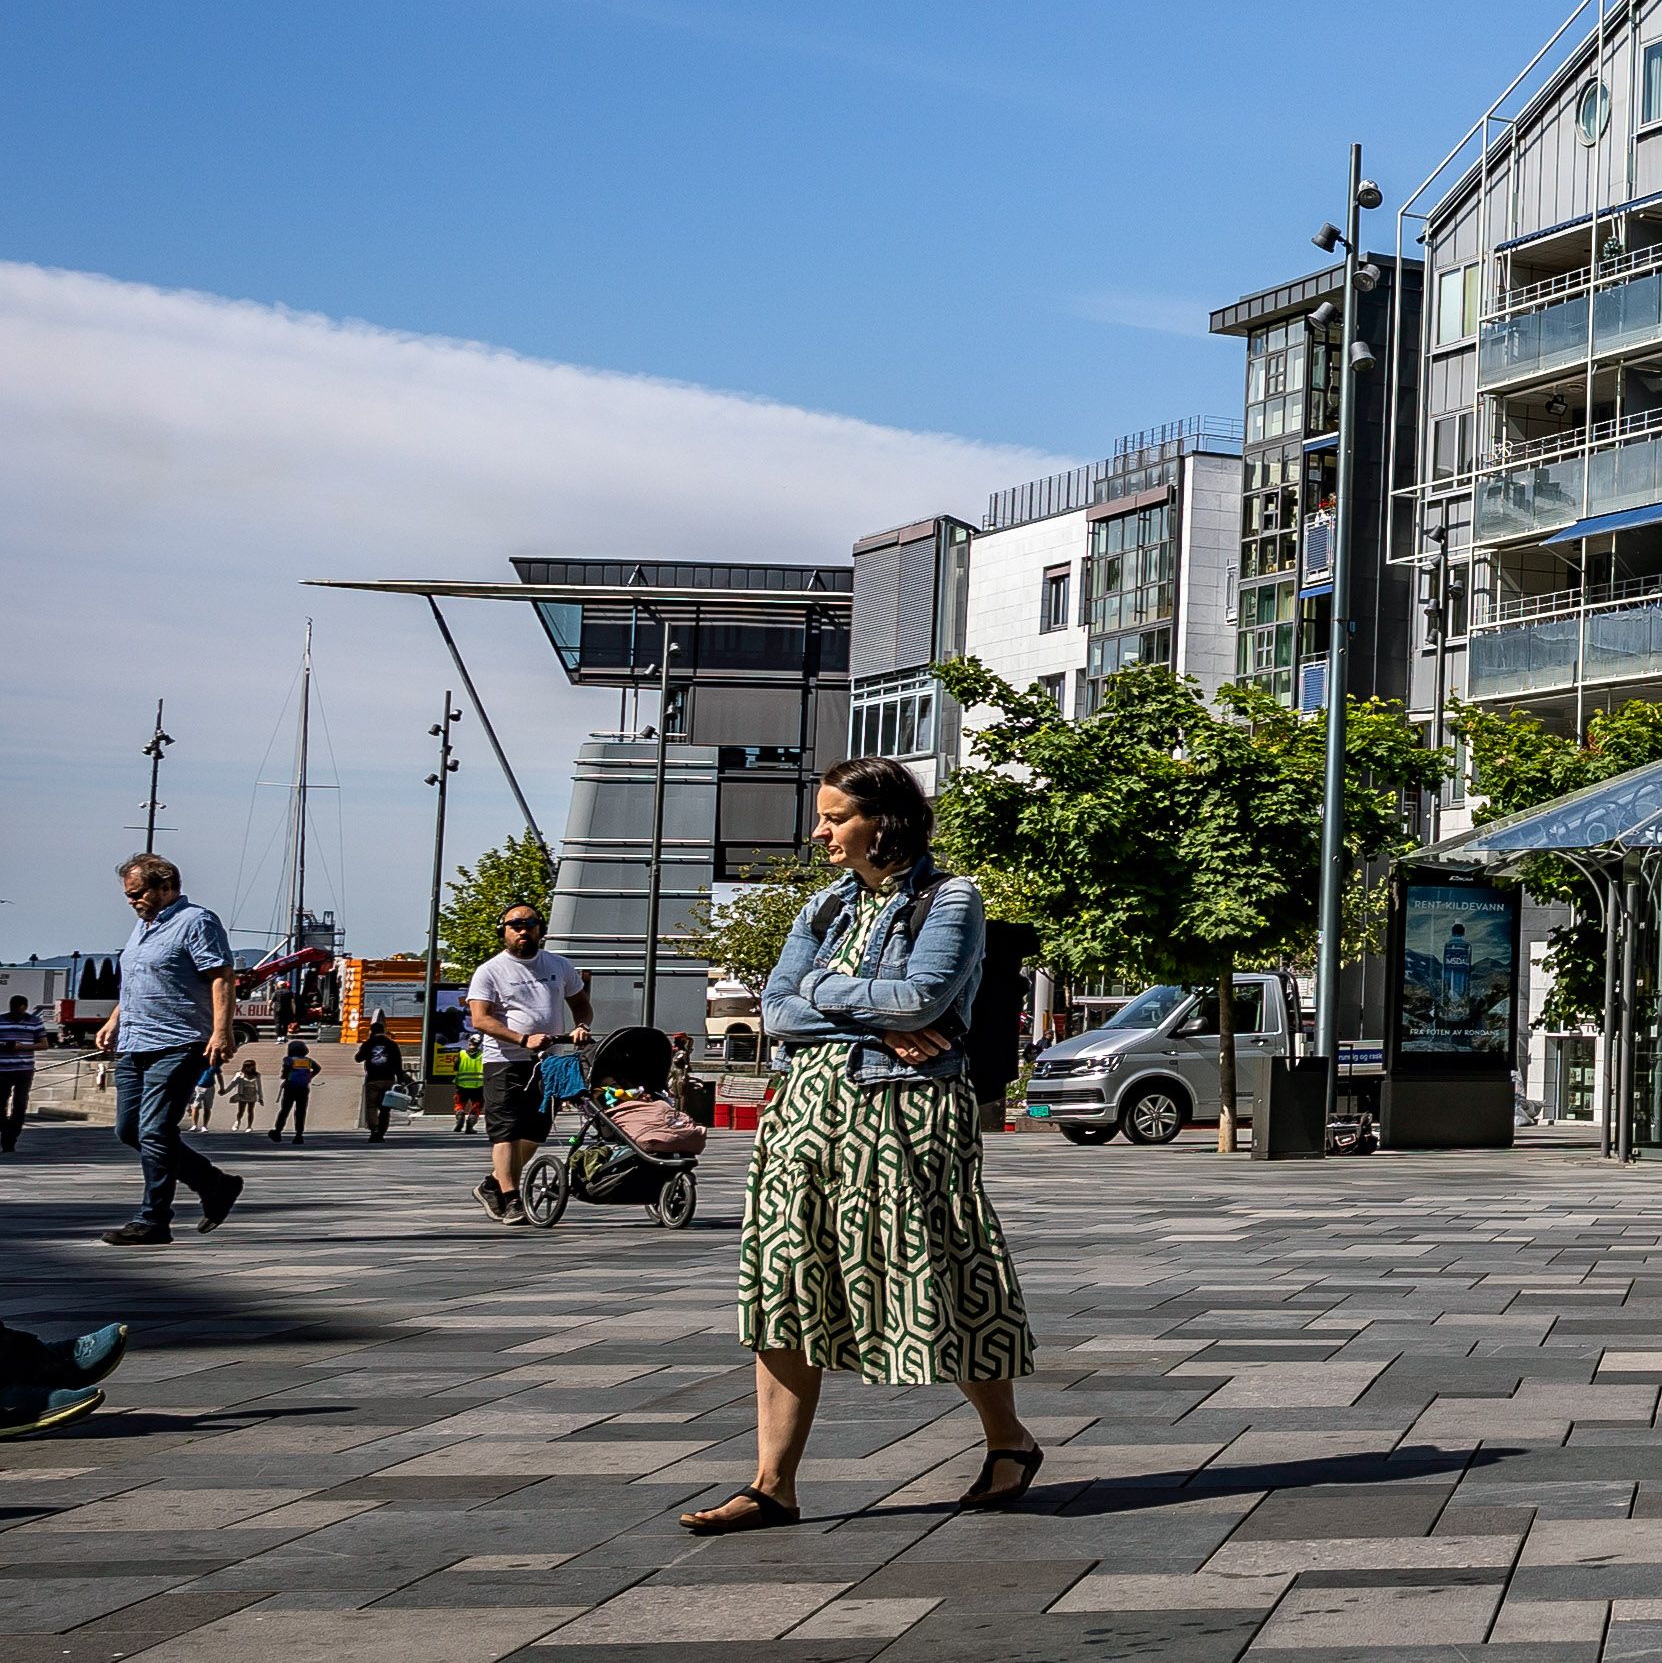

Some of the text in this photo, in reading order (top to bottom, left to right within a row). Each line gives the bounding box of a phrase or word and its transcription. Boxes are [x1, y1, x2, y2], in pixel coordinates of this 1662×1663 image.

[1414, 900, 1505, 912] RENT KILDEVANN
[1425, 1028, 1451, 1037] FOTEN
[1452, 1029, 1463, 1037] AV
